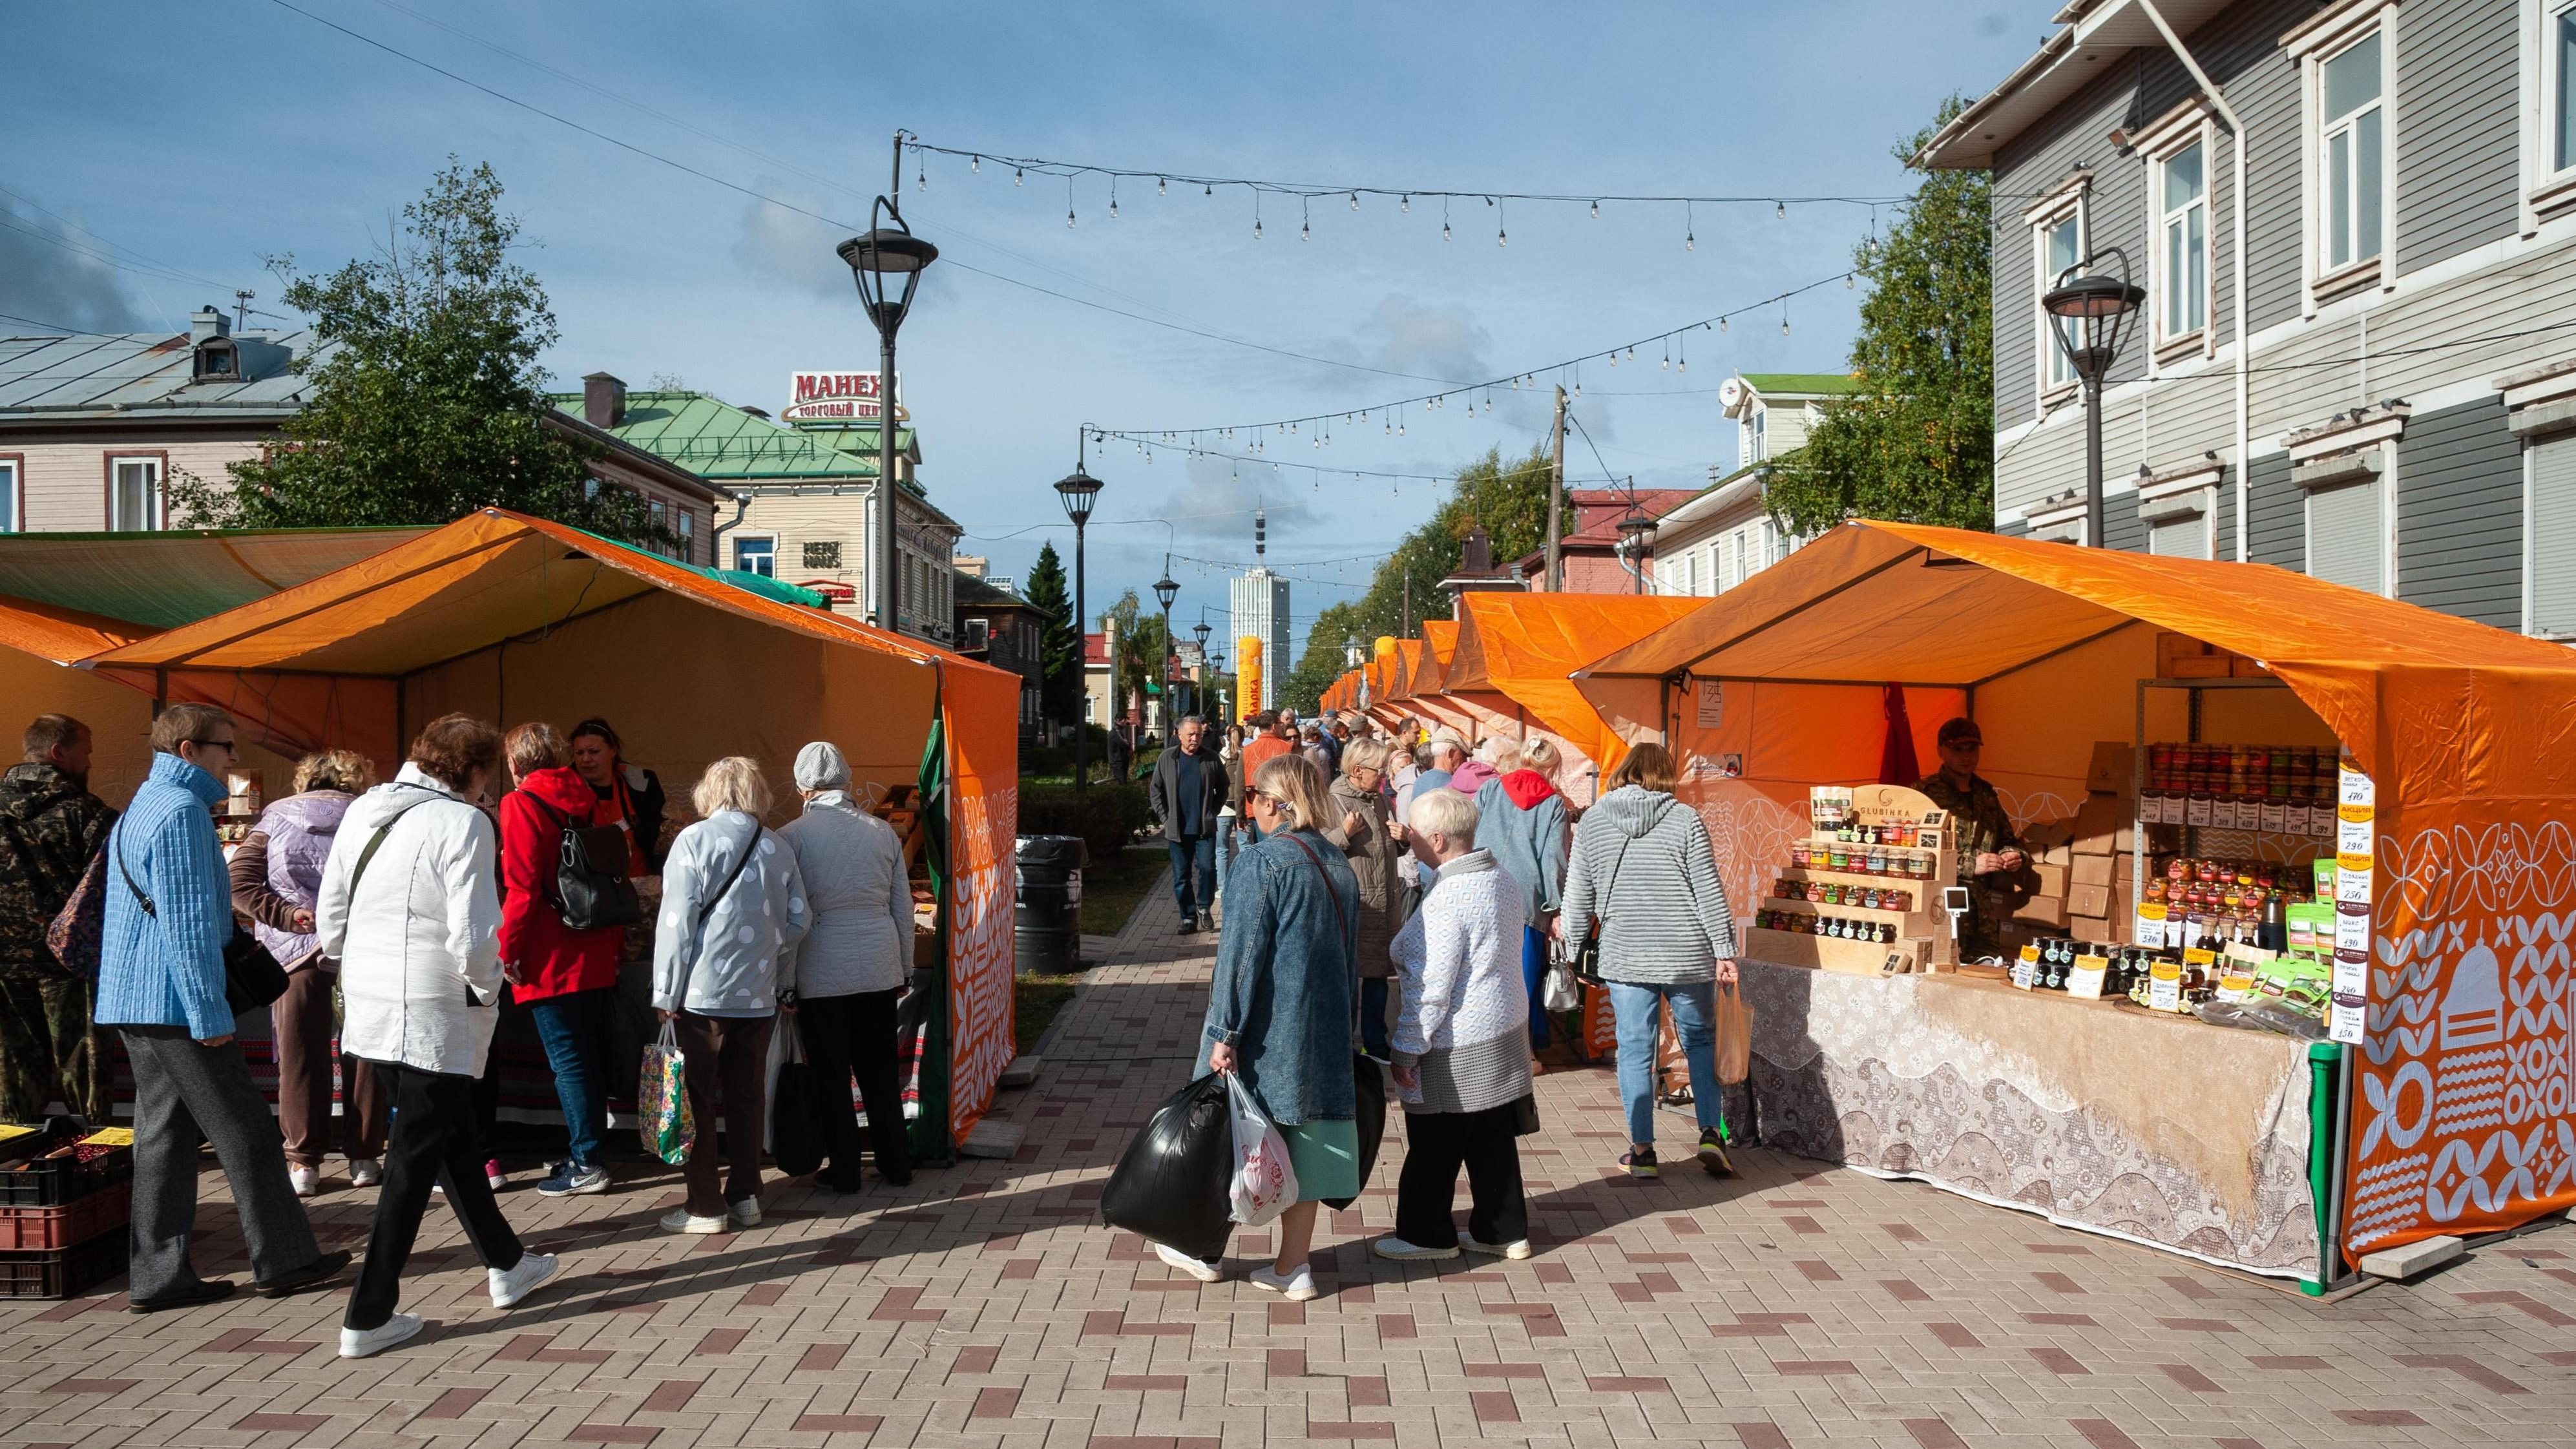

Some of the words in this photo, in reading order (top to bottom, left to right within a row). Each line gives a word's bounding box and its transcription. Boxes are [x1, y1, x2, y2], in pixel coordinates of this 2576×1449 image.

[799, 402, 853, 417] ТОРГОВЫЙ
[858, 404, 881, 417] ЦЕН
[1250, 679, 1259, 716] марка
[2347, 791, 2363, 801] 170
[1860, 807, 1911, 817] GLUBINKA
[2345, 842, 2363, 850] 290
[2344, 890, 2361, 900] 250
[2142, 934, 2157, 944] 370
[2343, 939, 2358, 947] 190
[2187, 949, 2212, 958] АКЦИЯ
[2341, 985, 2356, 994] 240
[2155, 996, 2173, 1007] 370
